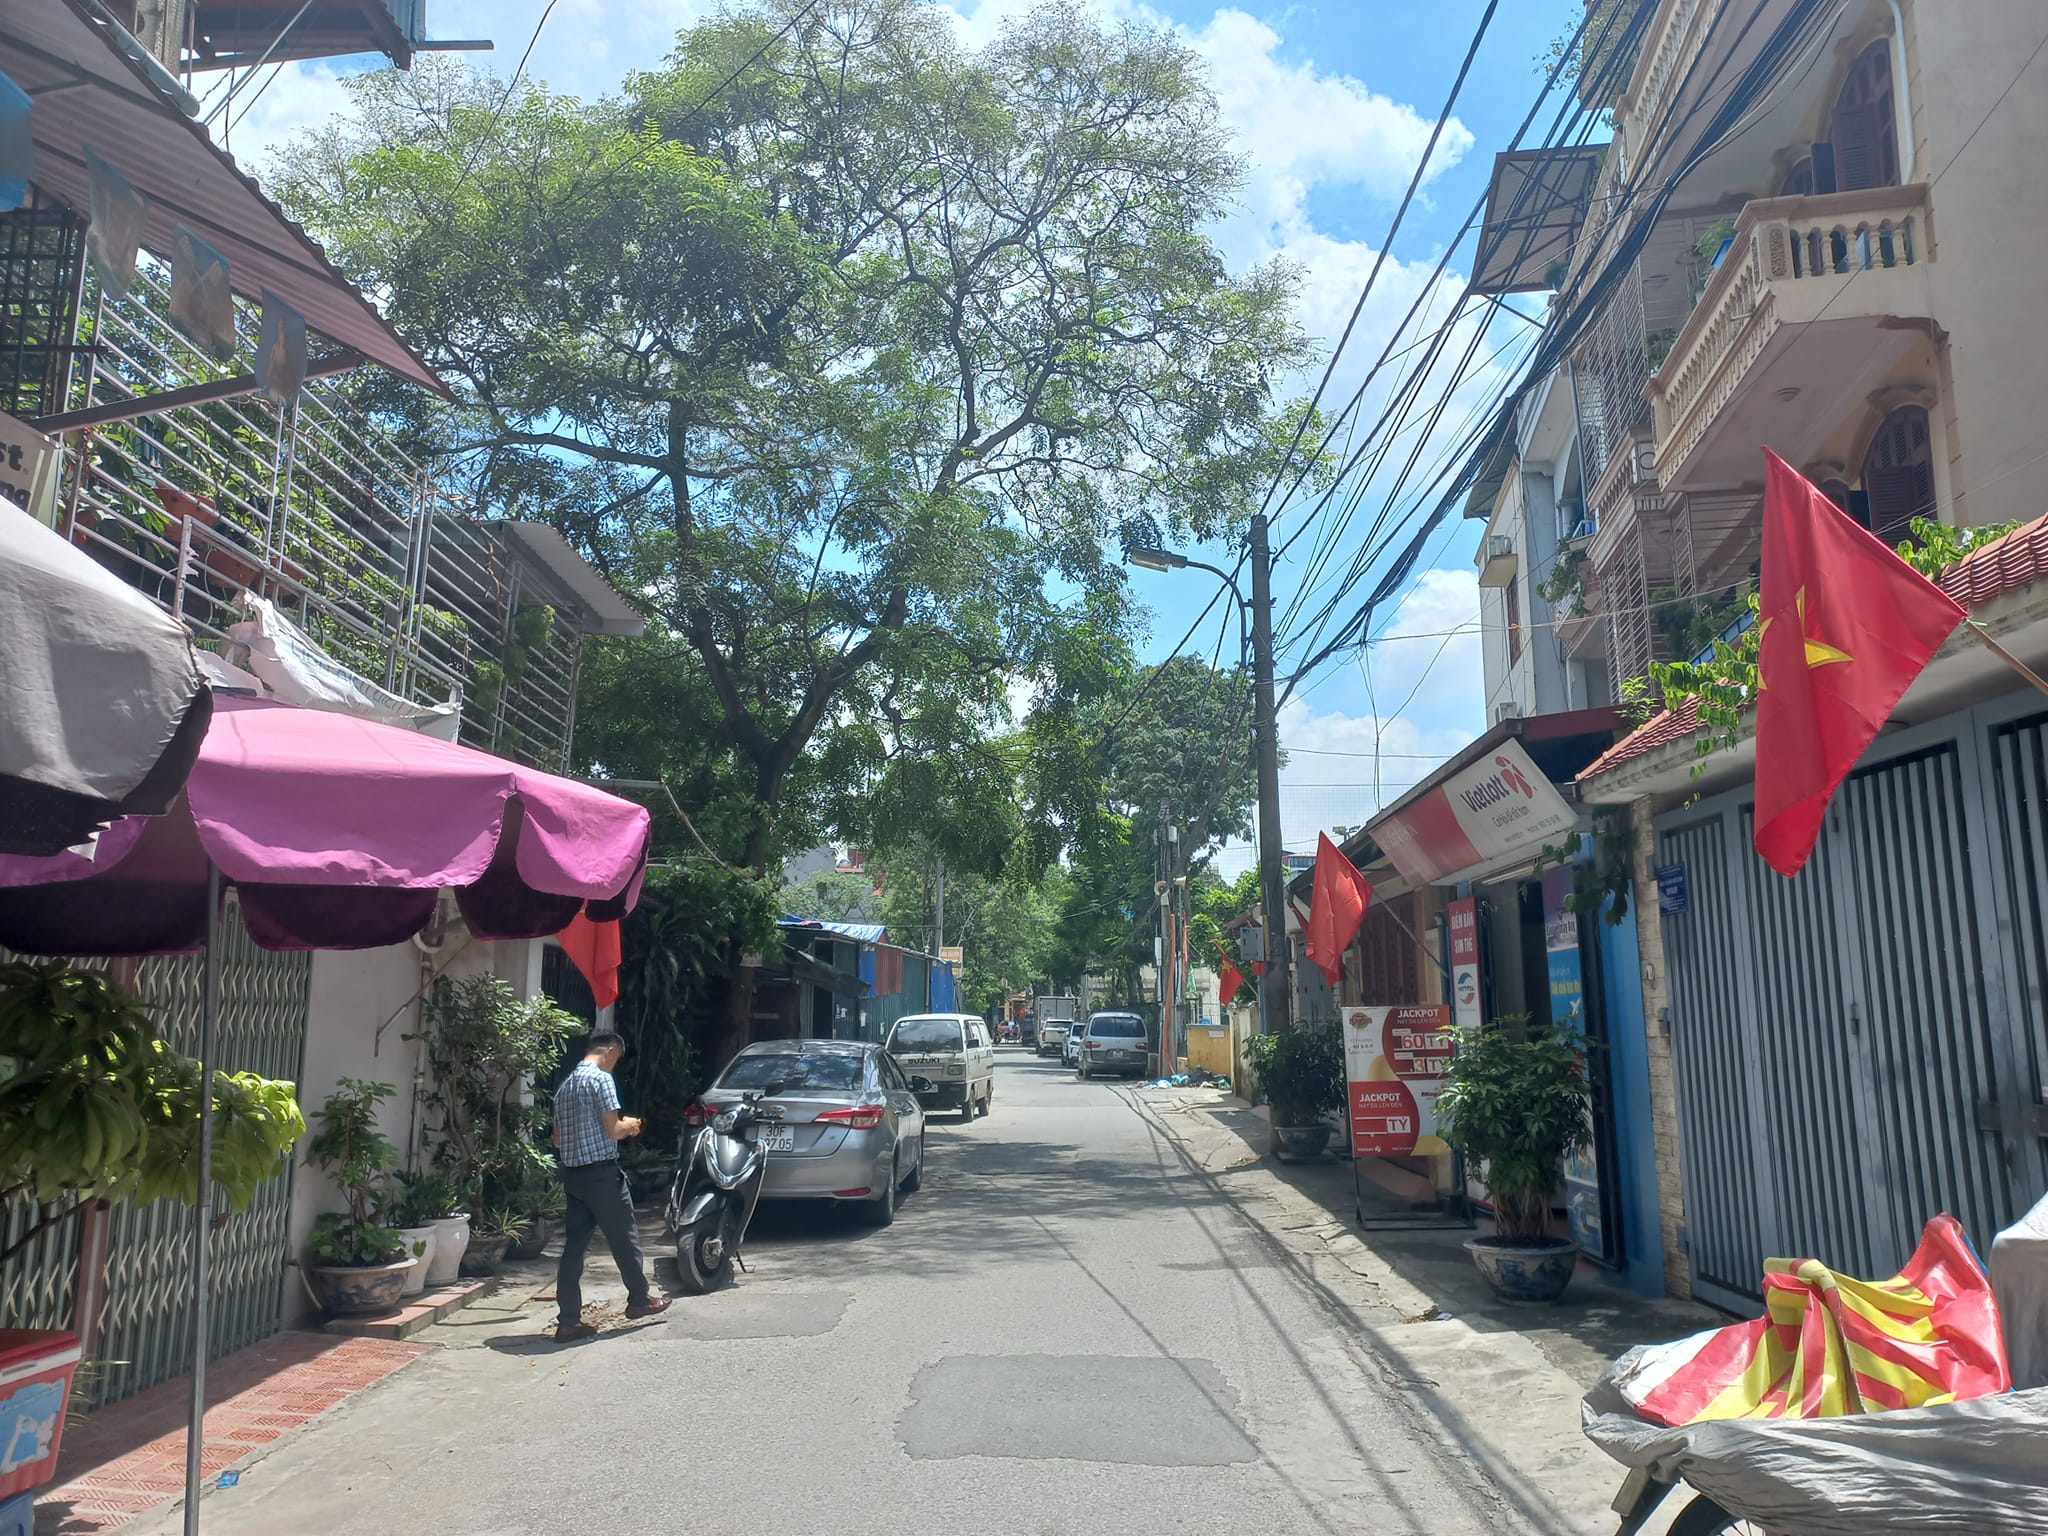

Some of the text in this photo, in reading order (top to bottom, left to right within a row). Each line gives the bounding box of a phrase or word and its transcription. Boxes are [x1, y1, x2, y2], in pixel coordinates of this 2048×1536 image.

[1460, 773, 1510, 813] Vietlott
[1397, 1008, 1439, 1019] JACKPOT
[907, 1057, 940, 1065] SUZUKI
[1359, 1093, 1401, 1102] JACKPOT
[766, 1126, 787, 1137] 30F
[759, 1138, 793, 1150] 97.05
